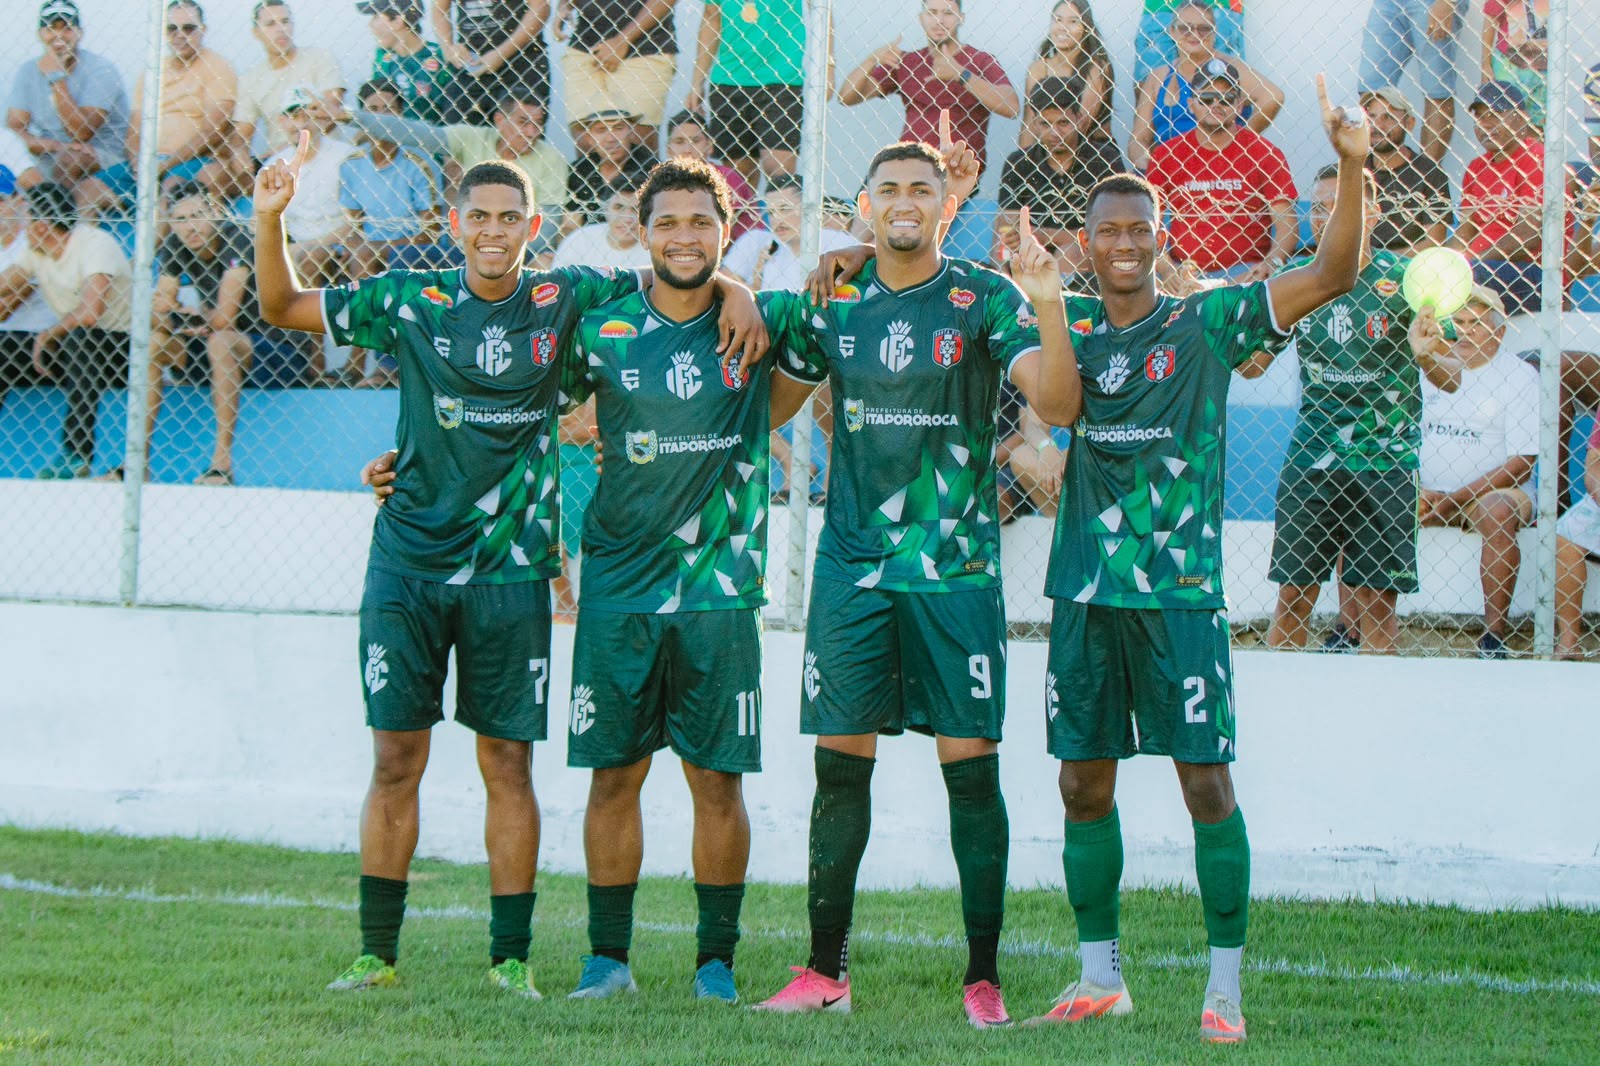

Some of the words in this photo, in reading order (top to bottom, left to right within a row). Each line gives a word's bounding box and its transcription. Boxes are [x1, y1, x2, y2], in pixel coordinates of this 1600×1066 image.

[879, 333, 914, 373] IFC
[666, 362, 703, 400] IFC
[658, 434, 706, 442] PREFEITURA
[865, 413, 959, 427] ITAPOROROCA
[365, 657, 389, 695] FC
[529, 658, 548, 704] 7
[968, 654, 992, 699] 9
[735, 691, 756, 736] 11
[1183, 676, 1207, 723] 2
